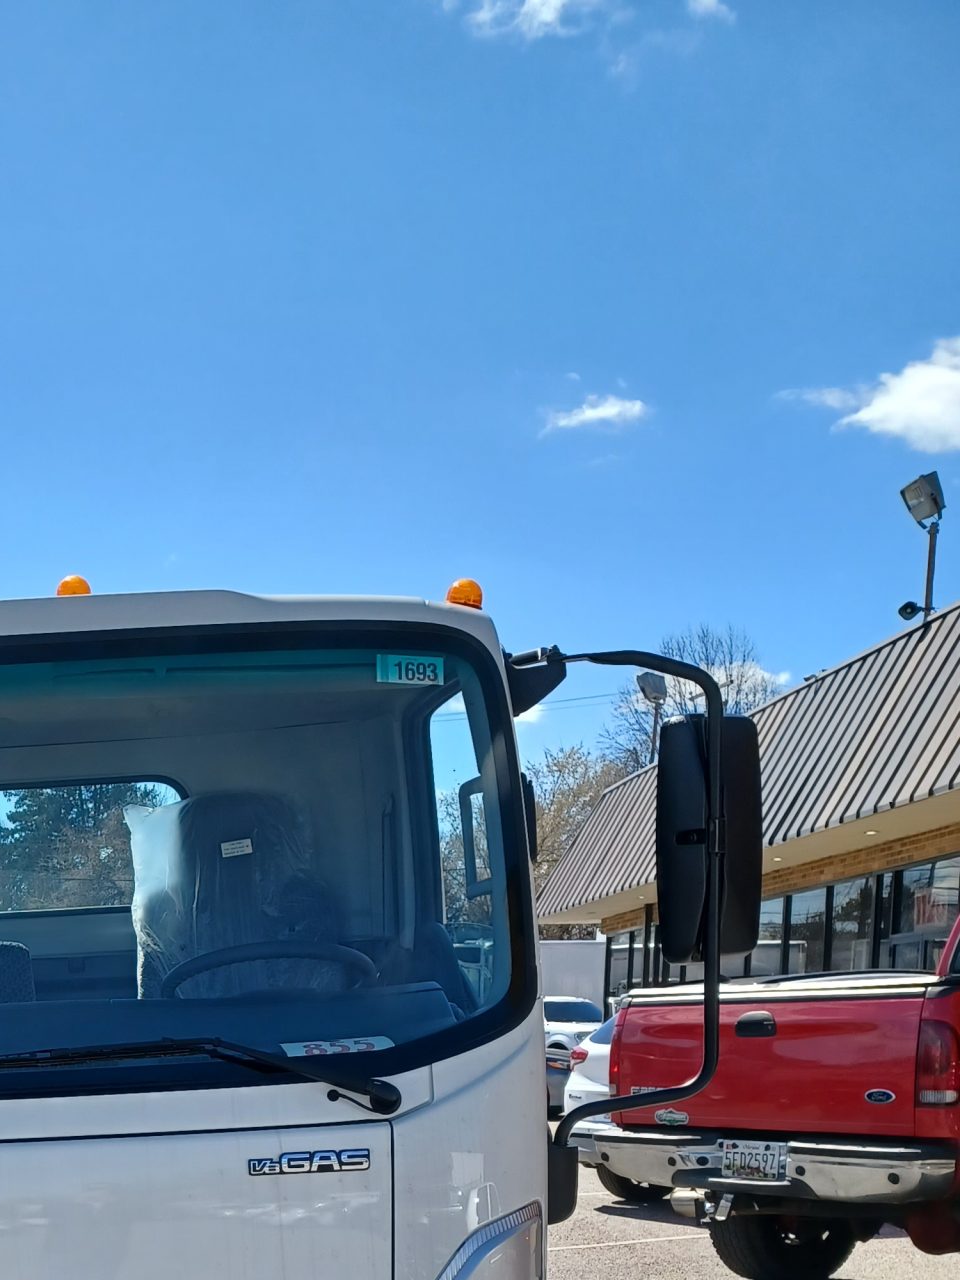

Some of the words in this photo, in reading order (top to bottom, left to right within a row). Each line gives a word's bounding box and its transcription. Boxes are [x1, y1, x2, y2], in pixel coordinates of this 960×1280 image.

[394, 661, 438, 681] 1693
[303, 1040, 375, 1056] 855
[281, 1150, 370, 1173] GAS
